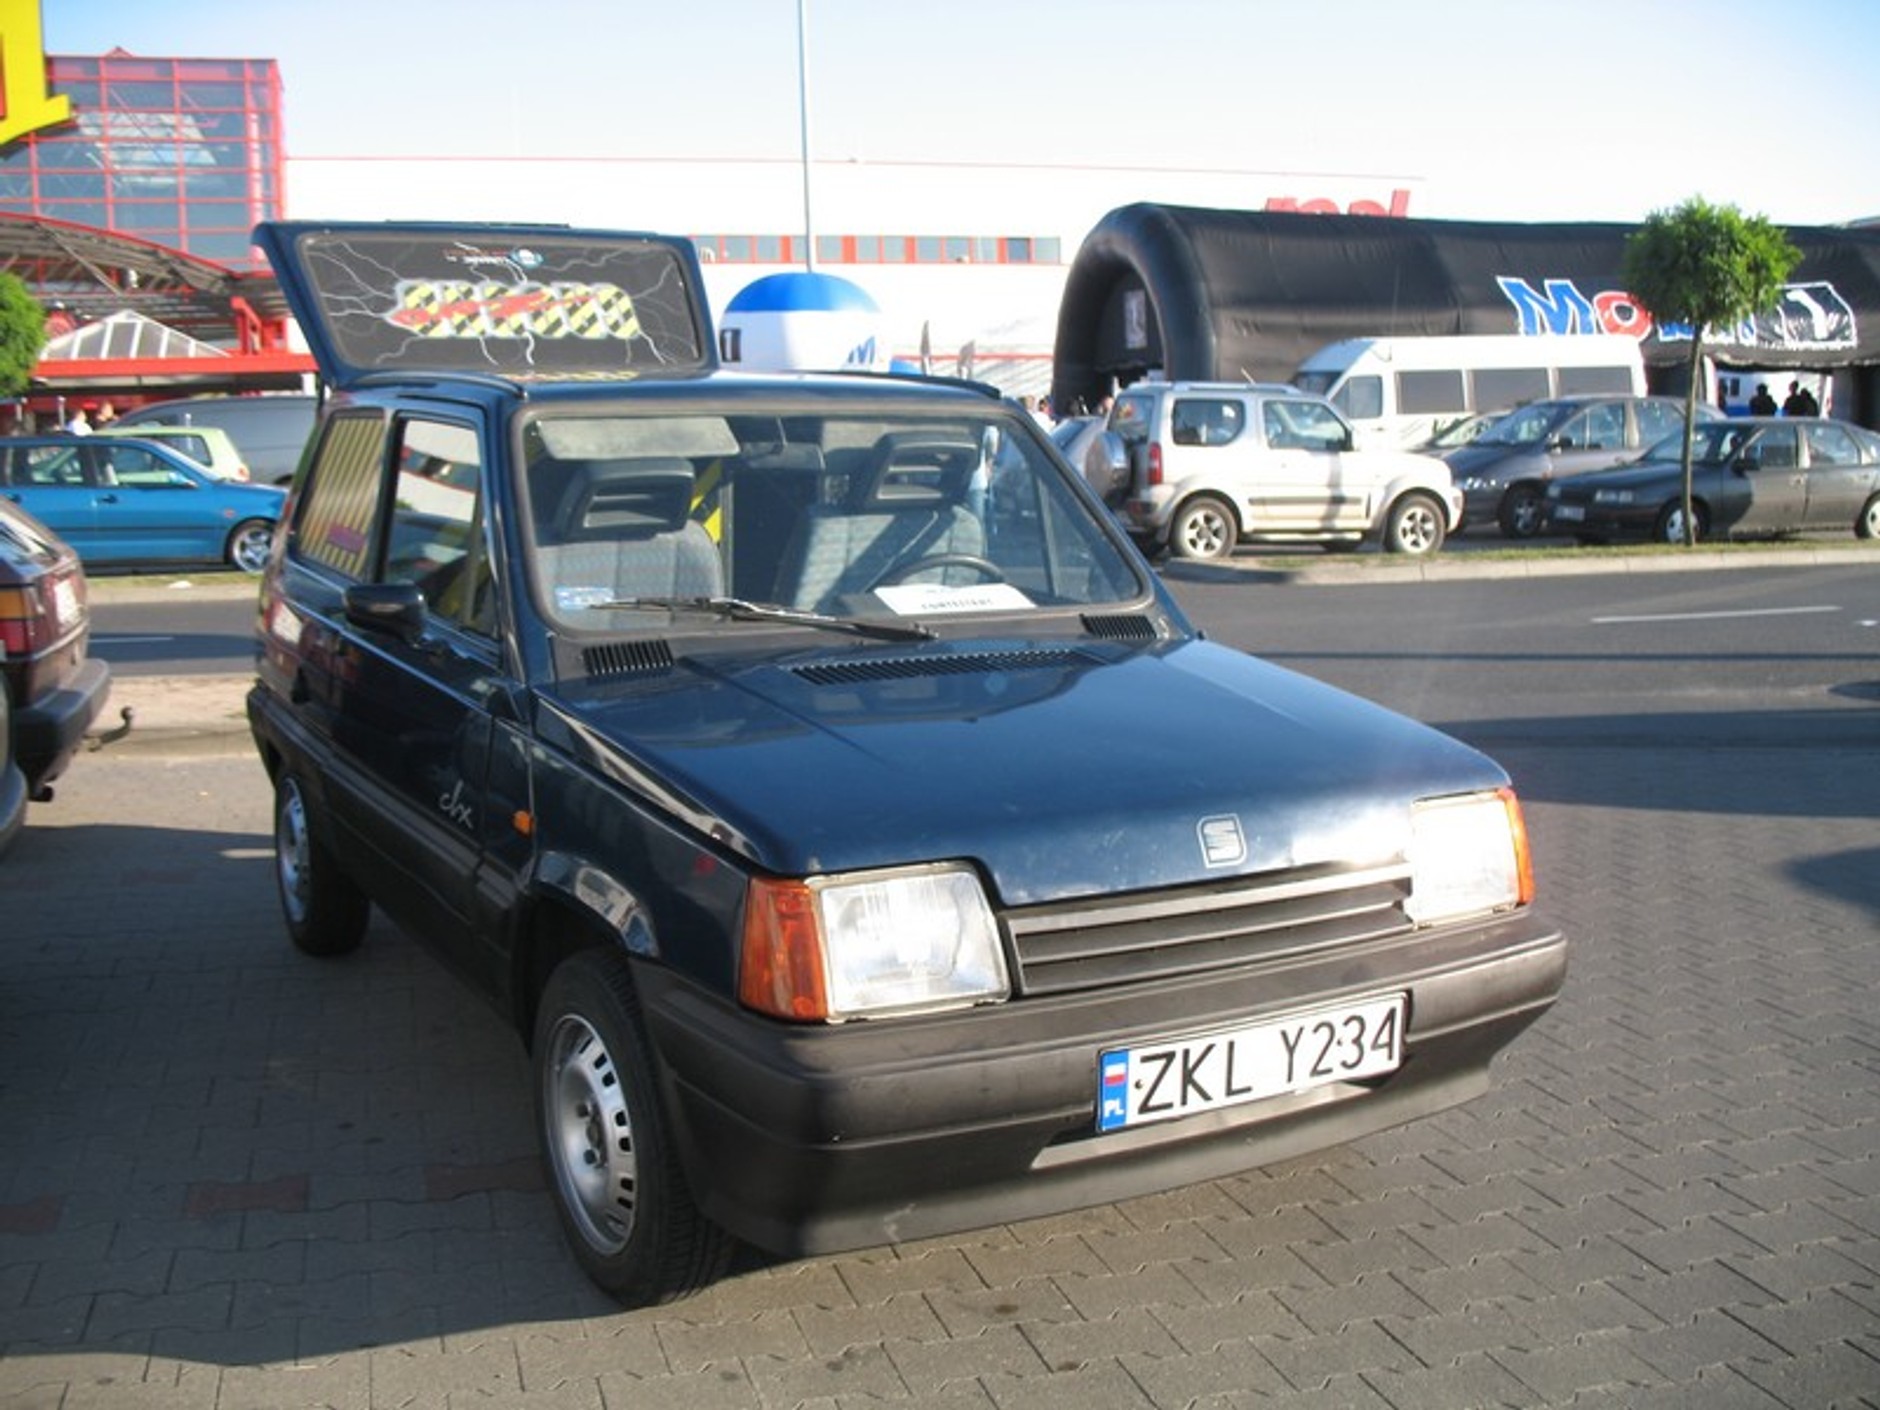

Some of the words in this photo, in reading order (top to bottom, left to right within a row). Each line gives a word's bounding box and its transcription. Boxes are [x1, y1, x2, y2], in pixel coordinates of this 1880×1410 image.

[1138, 1040, 1253, 1115] ZKL
[1281, 1006, 1398, 1083] Y234
[1104, 1098, 1124, 1117] PL
